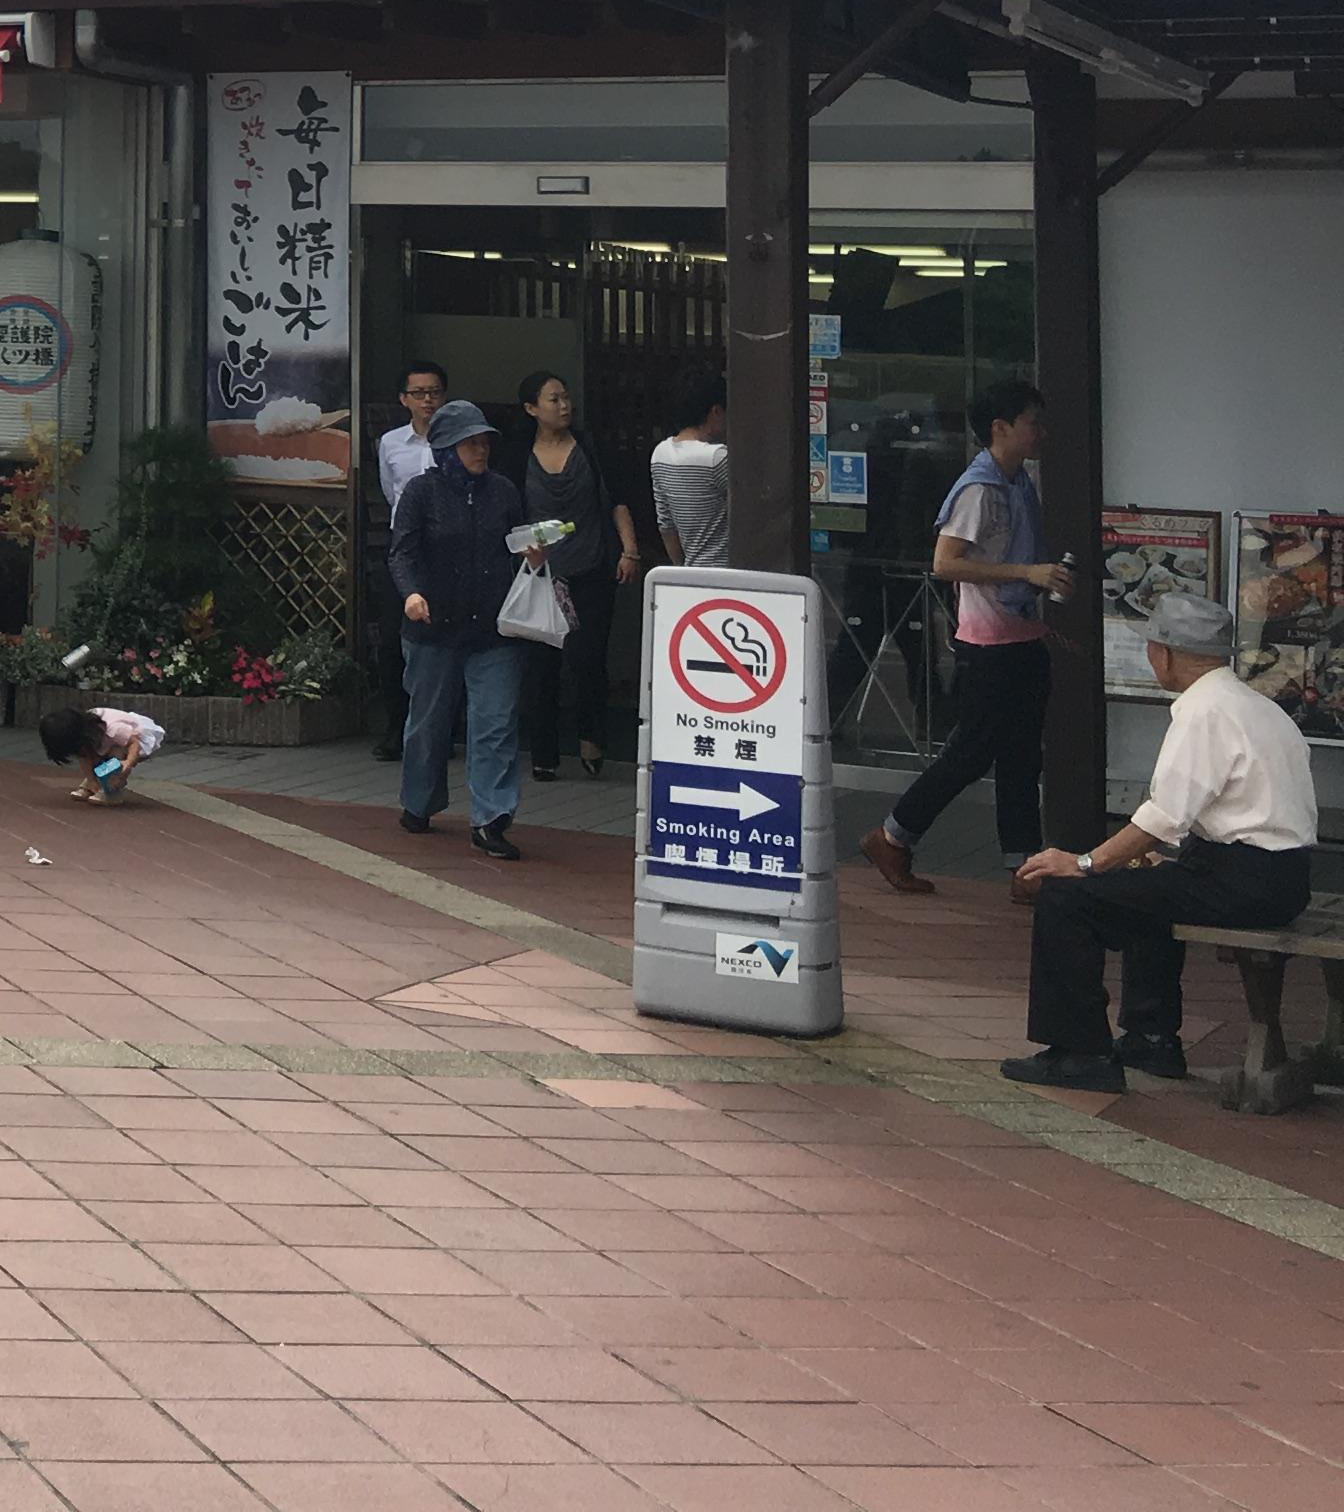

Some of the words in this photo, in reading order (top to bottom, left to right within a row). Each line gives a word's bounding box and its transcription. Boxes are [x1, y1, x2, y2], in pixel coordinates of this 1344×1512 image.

[275, 85, 340, 341] 毎日精米
[676, 713, 698, 728] No
[704, 716, 776, 738] Smoking
[694, 735, 757, 761] 禁煙
[656, 818, 740, 844] Smoking
[749, 828, 795, 847] Area
[664, 843, 785, 877] 喫煙場所
[721, 957, 762, 968] NEXCO
